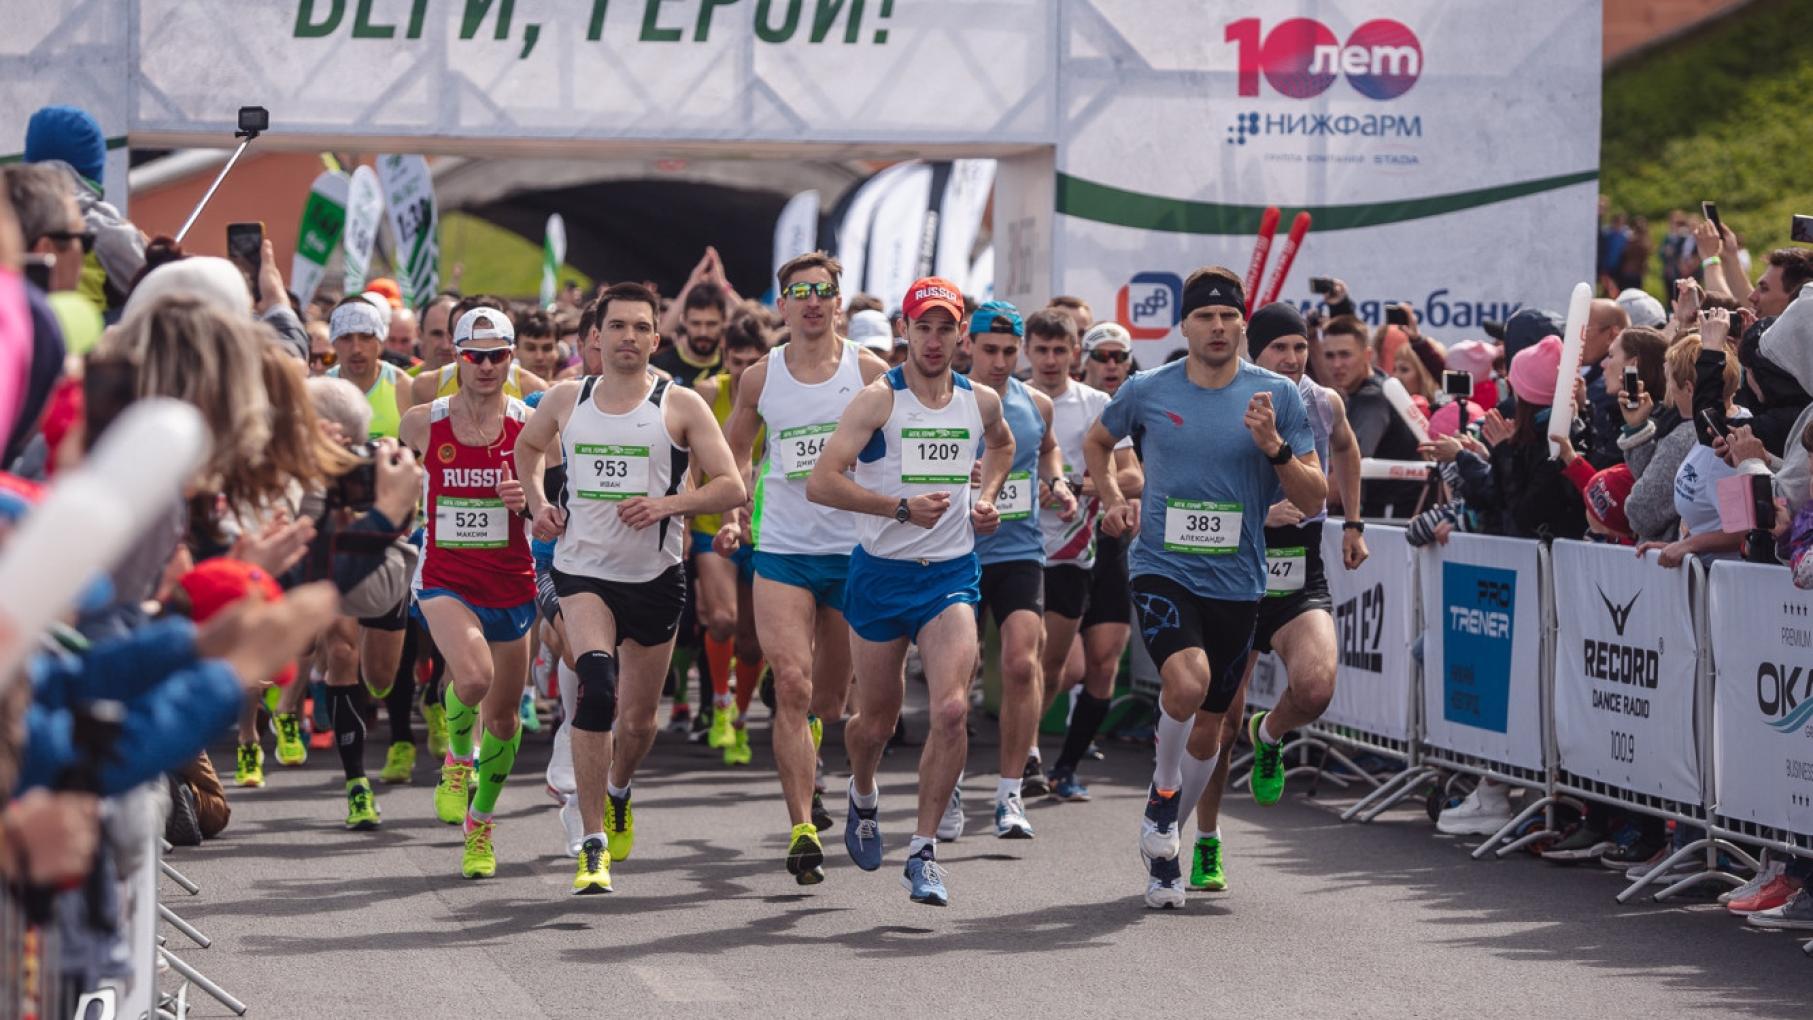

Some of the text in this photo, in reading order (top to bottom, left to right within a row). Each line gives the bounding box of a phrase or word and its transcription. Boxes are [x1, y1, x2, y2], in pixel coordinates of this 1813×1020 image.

[1224, 17, 1424, 100] 100
[917, 443, 960, 461] 1209
[442, 468, 513, 488] RUSSI
[594, 460, 628, 478] 953
[455, 512, 489, 528] 523
[1186, 515, 1222, 533] 383
[1180, 533, 1225, 544] АЛЕКСАНДР
[1449, 604, 1510, 640] TRENER
[1592, 688, 1649, 719] DANCE RADIO
[1610, 730, 1635, 764] 100.9
